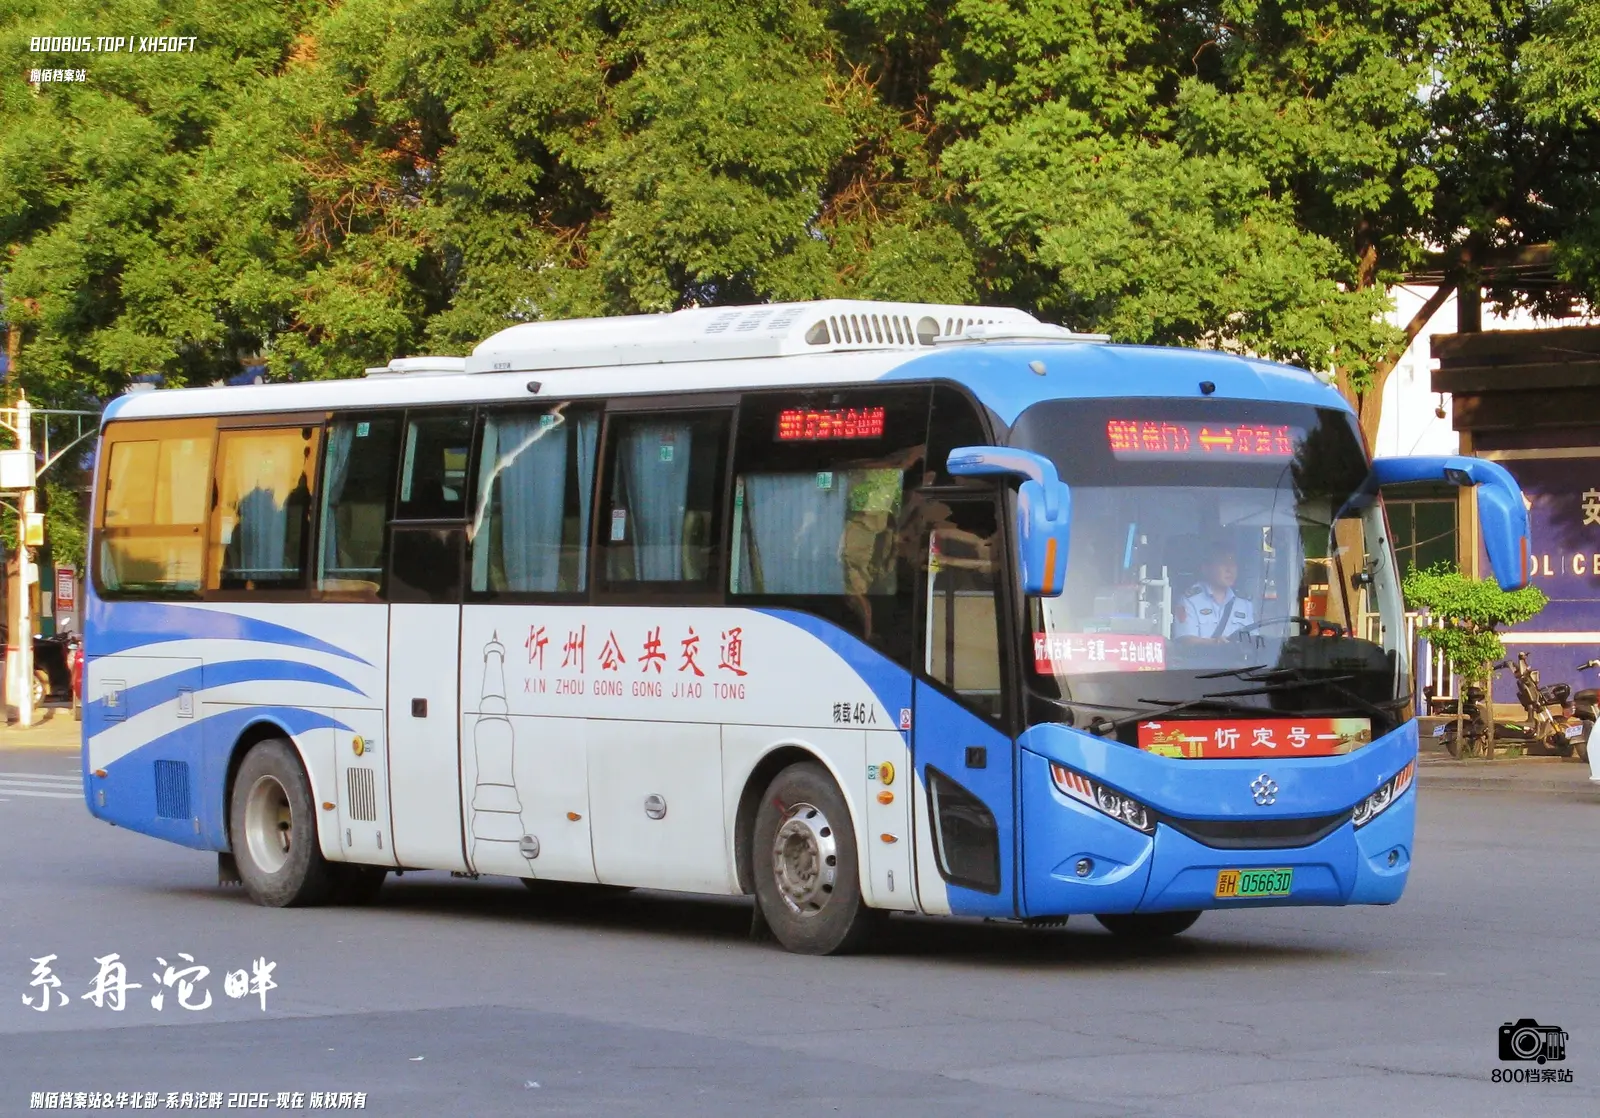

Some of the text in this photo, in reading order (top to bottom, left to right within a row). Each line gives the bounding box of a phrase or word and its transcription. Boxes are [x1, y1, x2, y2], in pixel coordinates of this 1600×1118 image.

[1582, 487, 1600, 526] 安
[524, 624, 749, 677] 忻州公共交通
[523, 677, 746, 700] XIN ZHOU GONG GONG JIAO TONG
[1213, 727, 1312, 750] 忻定号
